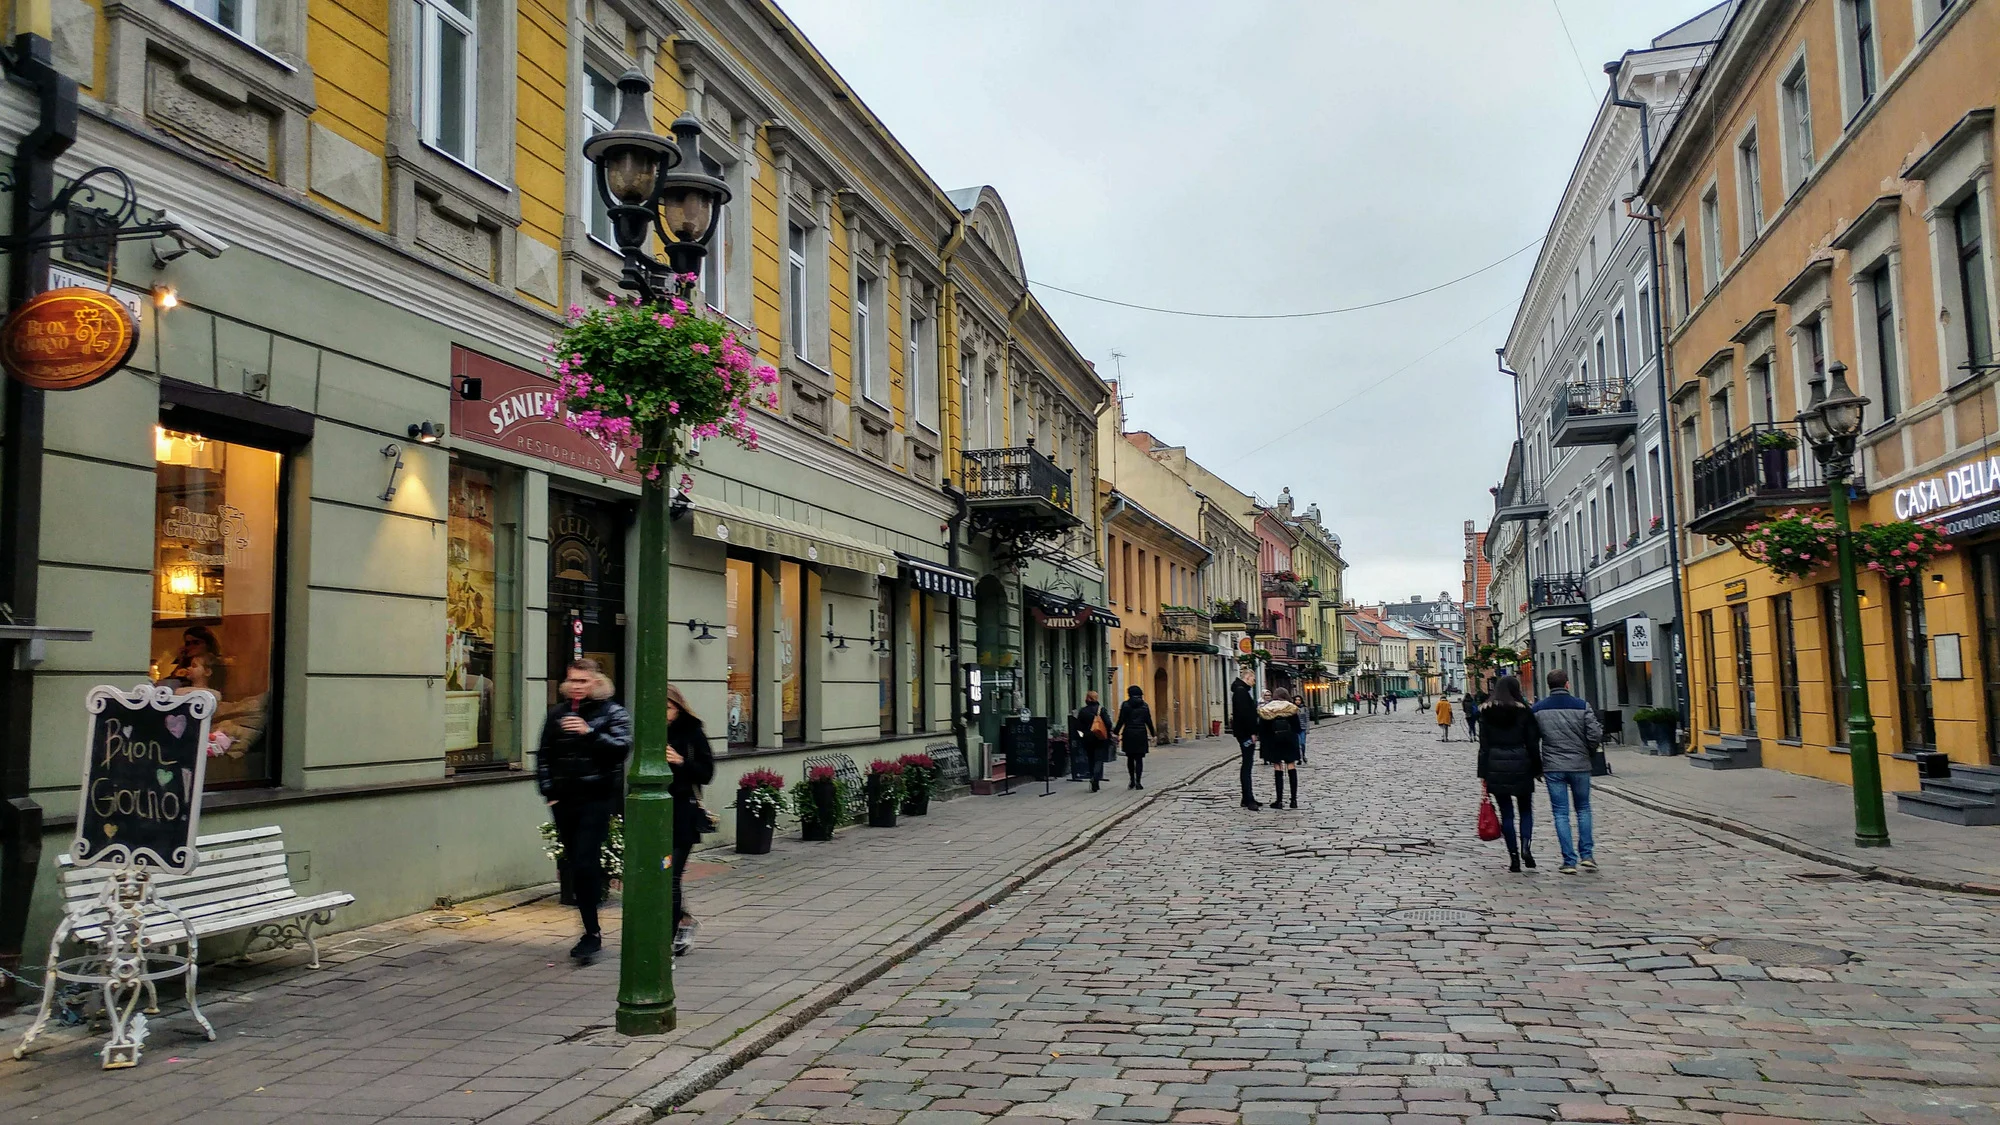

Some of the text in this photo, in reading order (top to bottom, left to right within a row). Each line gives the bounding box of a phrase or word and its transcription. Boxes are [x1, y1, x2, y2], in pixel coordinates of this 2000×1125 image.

[27, 320, 67, 336] BUON
[517, 435, 601, 470] RESTORANAS
[1894, 455, 2000, 520] CASA DELLA
[162, 518, 220, 545] GIORNO
[170, 505, 219, 530] BUON
[559, 517, 612, 575] CELLARS
[100, 718, 178, 770] Buon
[91, 767, 193, 823] Giorno!
